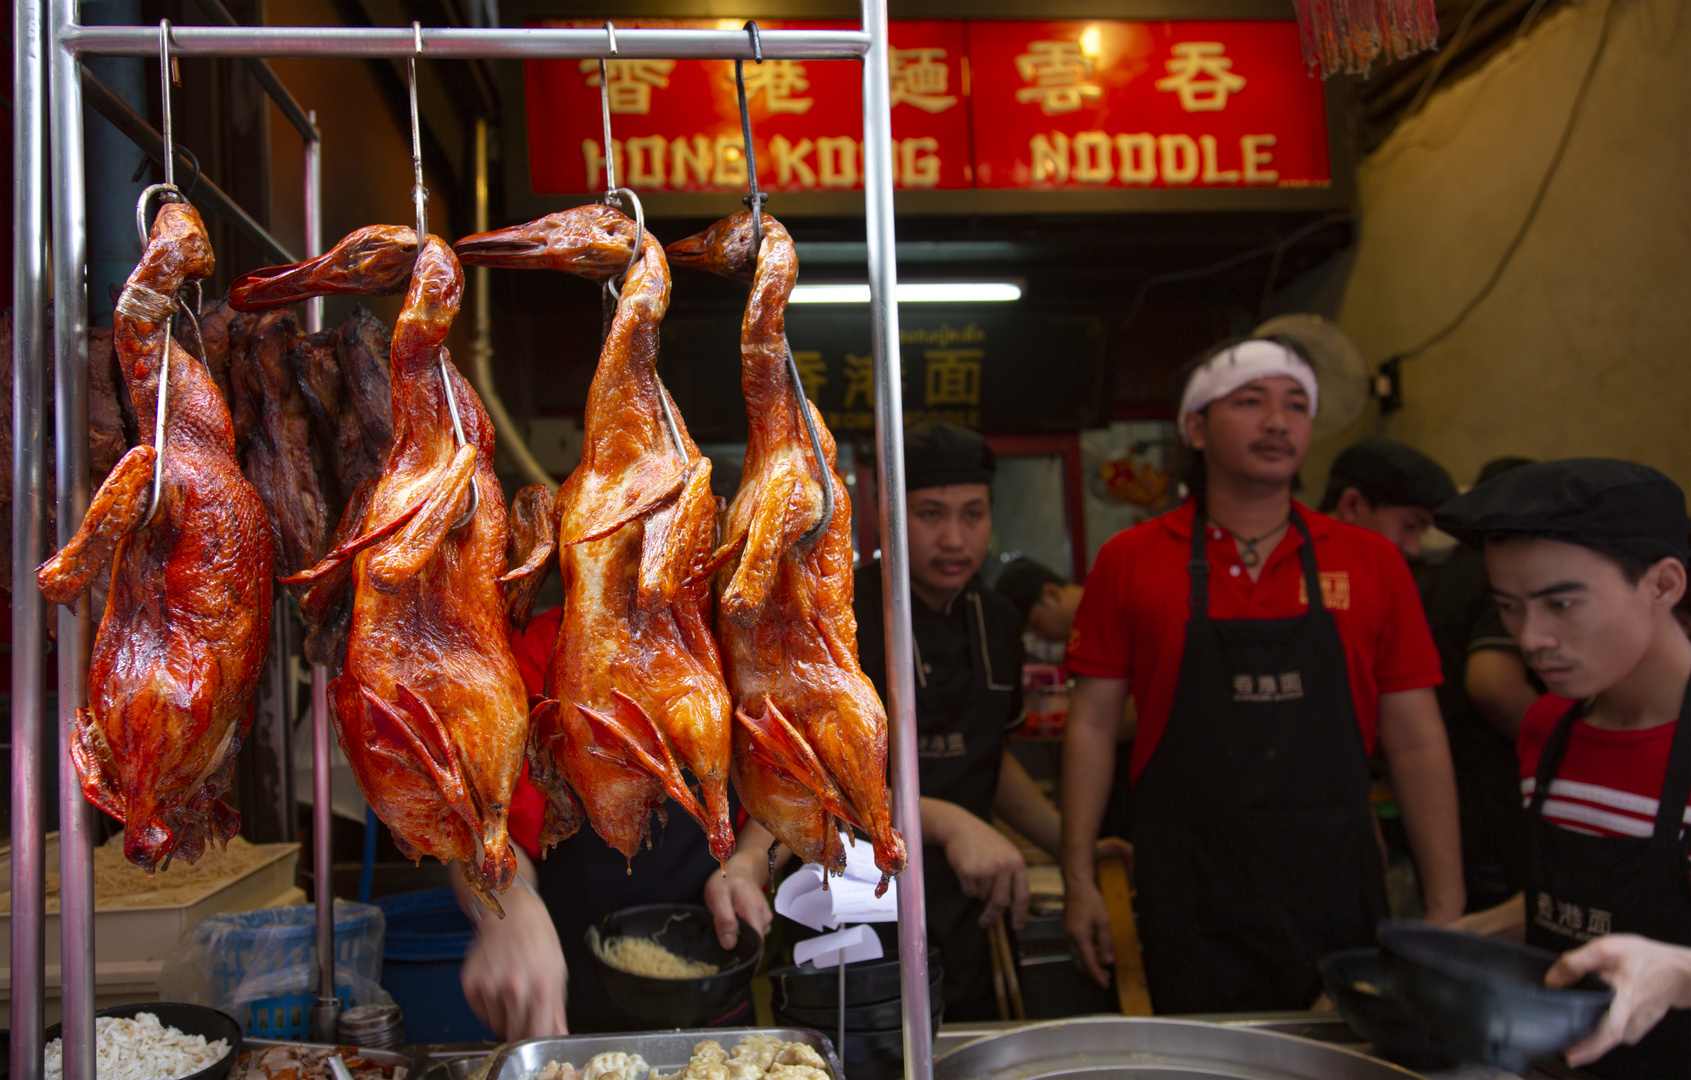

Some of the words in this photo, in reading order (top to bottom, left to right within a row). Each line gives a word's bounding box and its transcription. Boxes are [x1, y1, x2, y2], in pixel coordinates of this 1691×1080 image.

[582, 134, 749, 187] HONG
[769, 135, 942, 188] KOG
[1029, 131, 1279, 184] NOODLE
